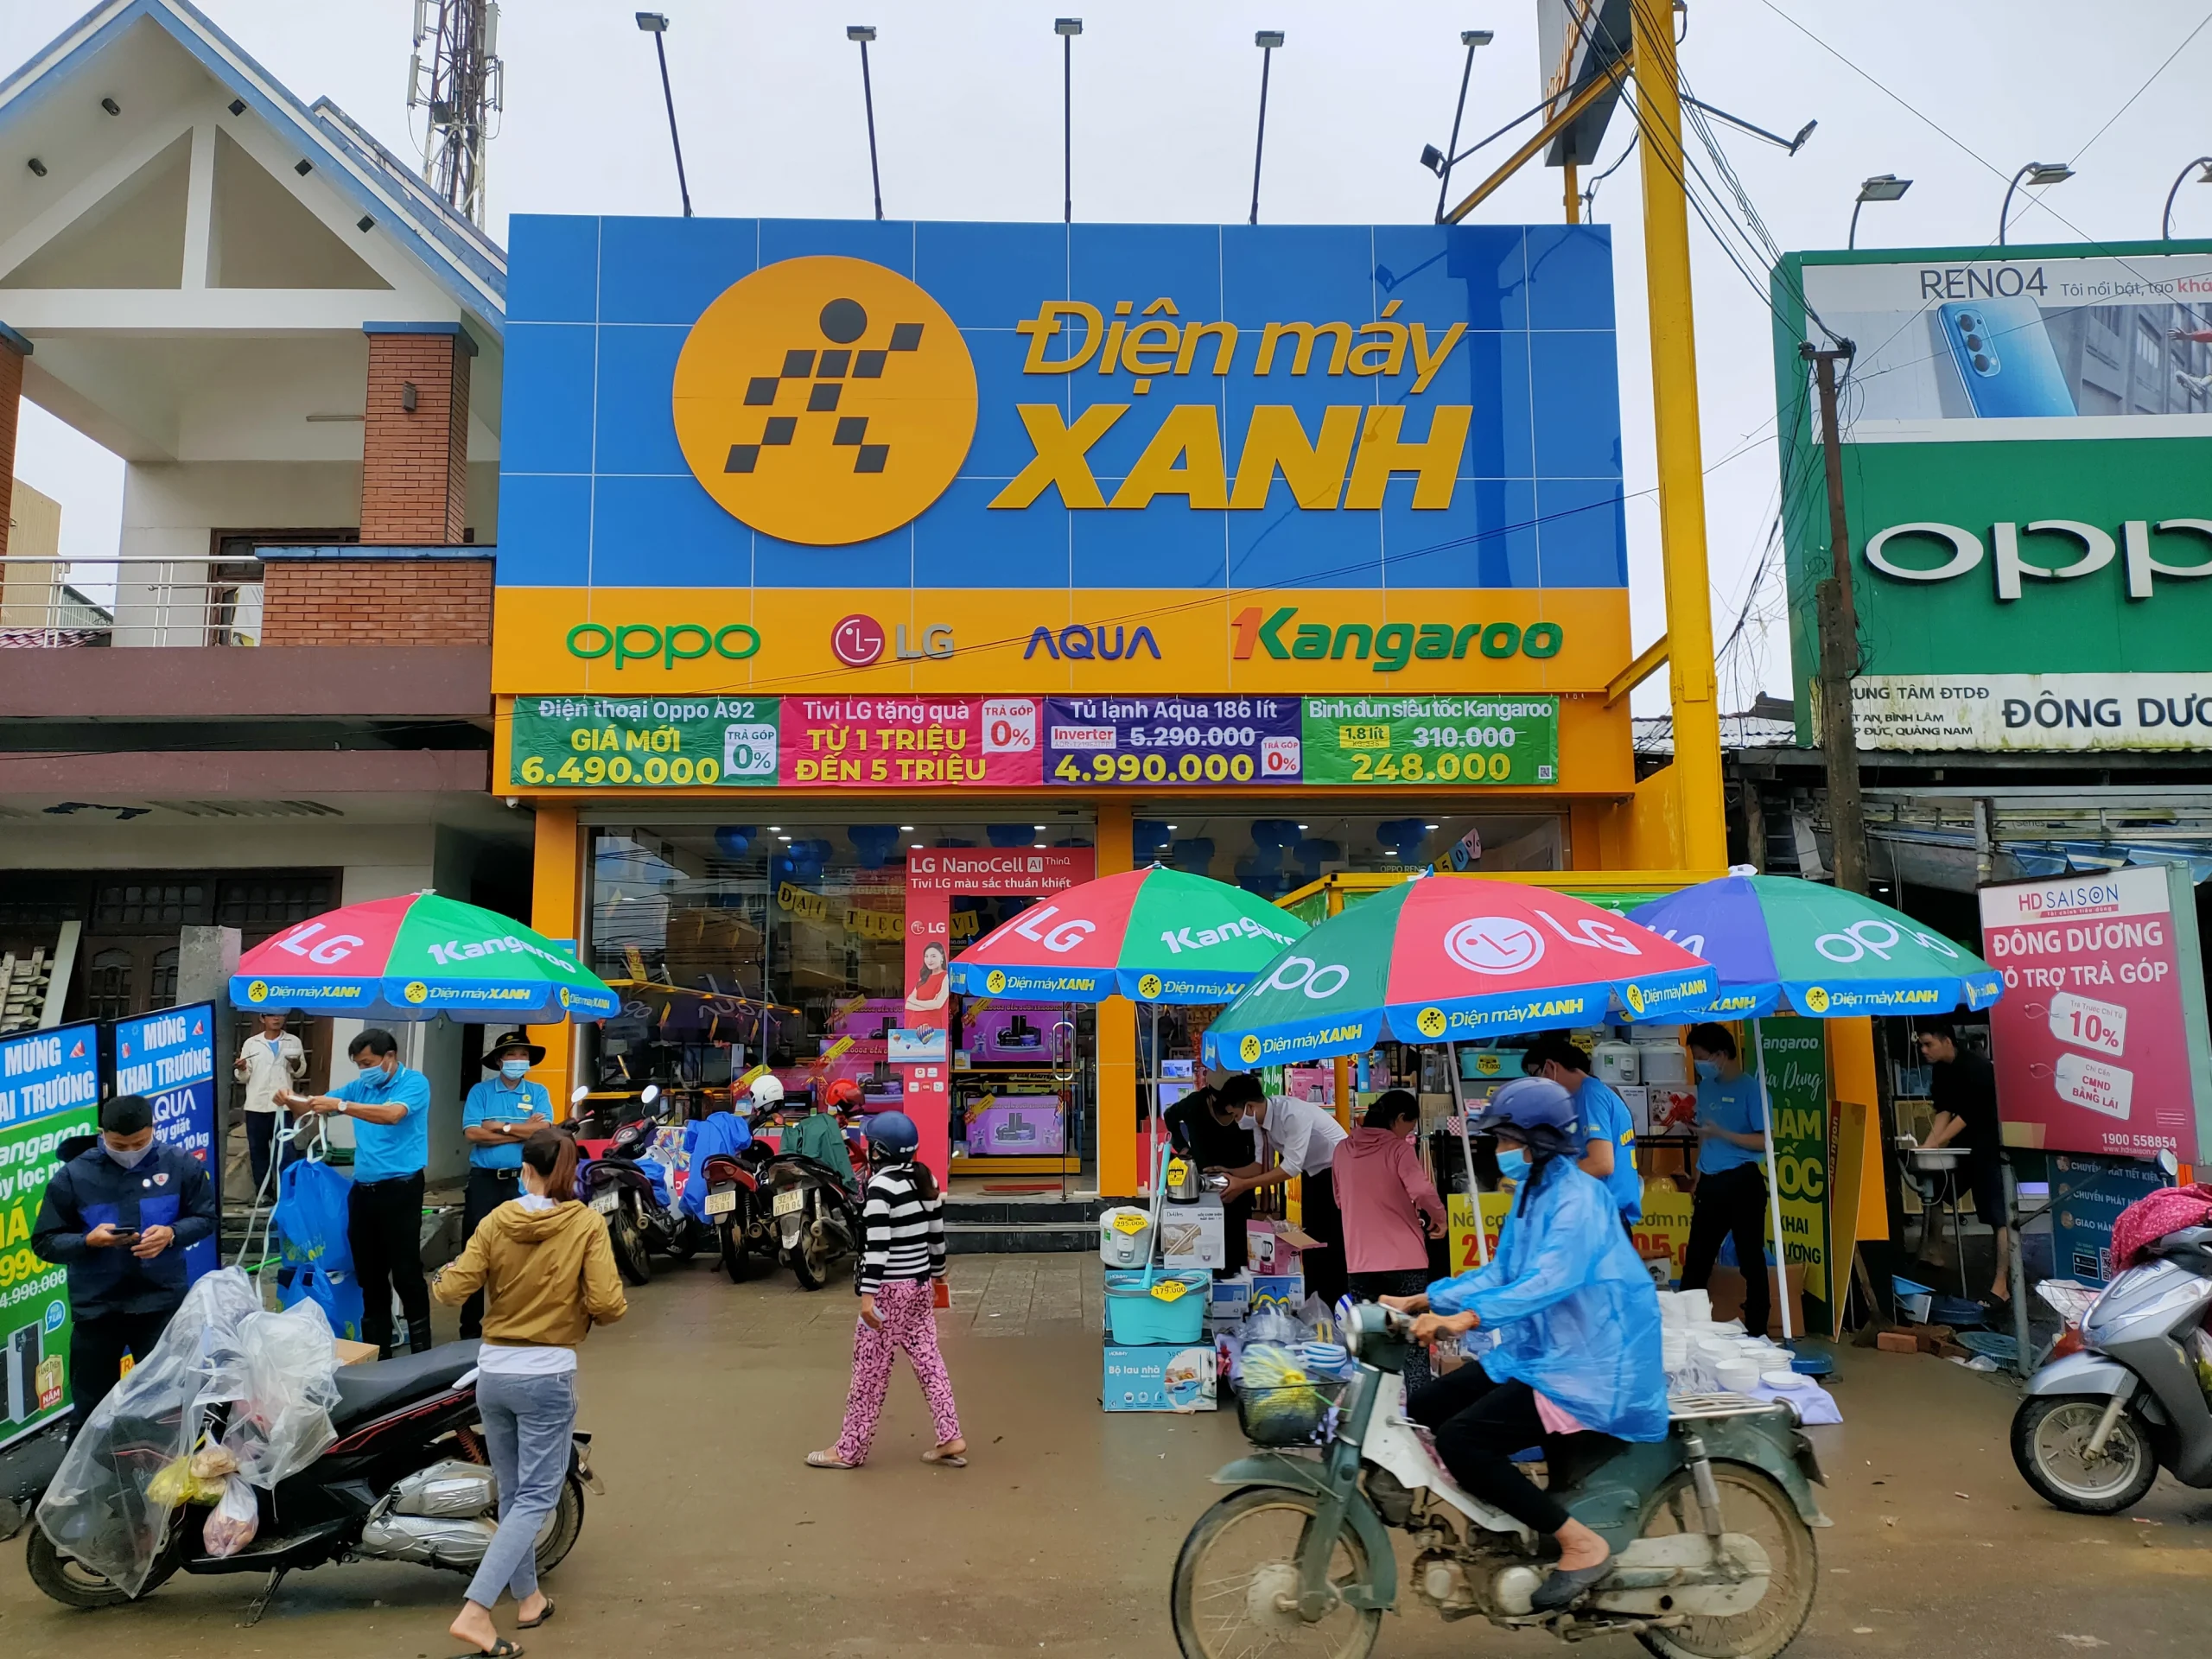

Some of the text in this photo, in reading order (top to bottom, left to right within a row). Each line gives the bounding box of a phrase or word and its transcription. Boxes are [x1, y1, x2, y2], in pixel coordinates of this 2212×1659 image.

[1920, 267, 2048, 300] RENO4
[2060, 283, 2084, 296] Tôi
[2087, 280, 2110, 296] nổi
[1015, 297, 1468, 395] Điện máy
[986, 403, 1473, 510] XANH
[566, 623, 761, 670] oppo
[895, 624, 954, 659] LG
[1023, 624, 1162, 660] AQUA
[1897, 684, 1935, 699] TÂM
[1940, 687, 1990, 699] ĐTDĐ
[538, 700, 755, 723] Điện thoại Oppo A92
[803, 701, 969, 724] Tivi LG tặng quà
[984, 704, 1033, 716] TRẢ GÓP
[1070, 700, 1278, 724] Tủ lạnh Aqua 186 lít
[1309, 700, 1353, 719] Bình
[1354, 701, 1391, 719] đun
[1464, 702, 1553, 723] Kangaroo
[1885, 711, 1913, 722] BÌNH
[1916, 712, 1944, 722] LÂM
[2001, 690, 2120, 728] ĐÔNG
[570, 723, 681, 753] GIÁ MỚI
[727, 727, 775, 741] TRẢ GÓP
[808, 723, 966, 756] TỪ 1 TRIỆU
[989, 721, 1032, 747] 0%
[1053, 727, 1255, 747] Inverter 5.290.000
[1345, 727, 1516, 747] 1.8 lít 310.000
[1944, 727, 1973, 735] NAM
[1263, 740, 1300, 749] TRẢ GÓP
[732, 744, 772, 770] 0%
[1054, 753, 1255, 782] 4.990.000
[1267, 752, 1297, 772] 0%
[1351, 753, 1511, 781] 248.000
[521, 756, 720, 785] 6.490.000
[795, 753, 987, 785] ĐẾN 5 TRIỆU
[911, 856, 1071, 873] LG NanoCell AI ThinQ
[911, 875, 1071, 889] Tivi LG màu sắc thuần khiết
[2046, 883, 2119, 909] SAISON
[928, 922, 945, 933] LG
[1014, 906, 1096, 953] LG
[1535, 908, 1643, 956] LG
[1993, 921, 2163, 957] ĐÔNG DƯƠNG
[280, 922, 365, 964] LG
[1007, 976, 1032, 989] Điện
[2026, 967, 2066, 991] TRỢ
[2073, 959, 2115, 987] TRẢ
[2120, 957, 2169, 983] GÓP
[269, 985, 299, 999] Điện
[428, 986, 461, 1001] Điện
[1164, 980, 1195, 996] Điện
[1643, 986, 1663, 1003] Điện
[1831, 992, 1863, 1007] Điện
[1449, 1007, 1487, 1028] Điện
[2069, 1010, 2120, 1048] 10%
[143, 1016, 187, 1052] MỪNG
[1262, 1036, 1294, 1053] Điện
[4, 1037, 62, 1077] MỪNG
[117, 1046, 212, 1097] KHAI TRƯƠNG
[2082, 1075, 2111, 1091] CMND
[21, 1070, 95, 1116] TRƯƠNG
[153, 1089, 197, 1123] QUA
[169, 1117, 190, 1141] giặt
[2101, 1132, 2177, 1149] 1900 558854
[184, 1135, 195, 1151] 10
[196, 1132, 209, 1147] kg
[17, 1166, 46, 1193] lọc
[2074, 1189, 2126, 1207] CHUYỂN PHÁT
[2075, 1218, 2096, 1230] GIAO
[1109, 1365, 1122, 1377] Bộ
[1141, 1364, 1160, 1374] nhà
[42, 1389, 60, 1404] NĂM
